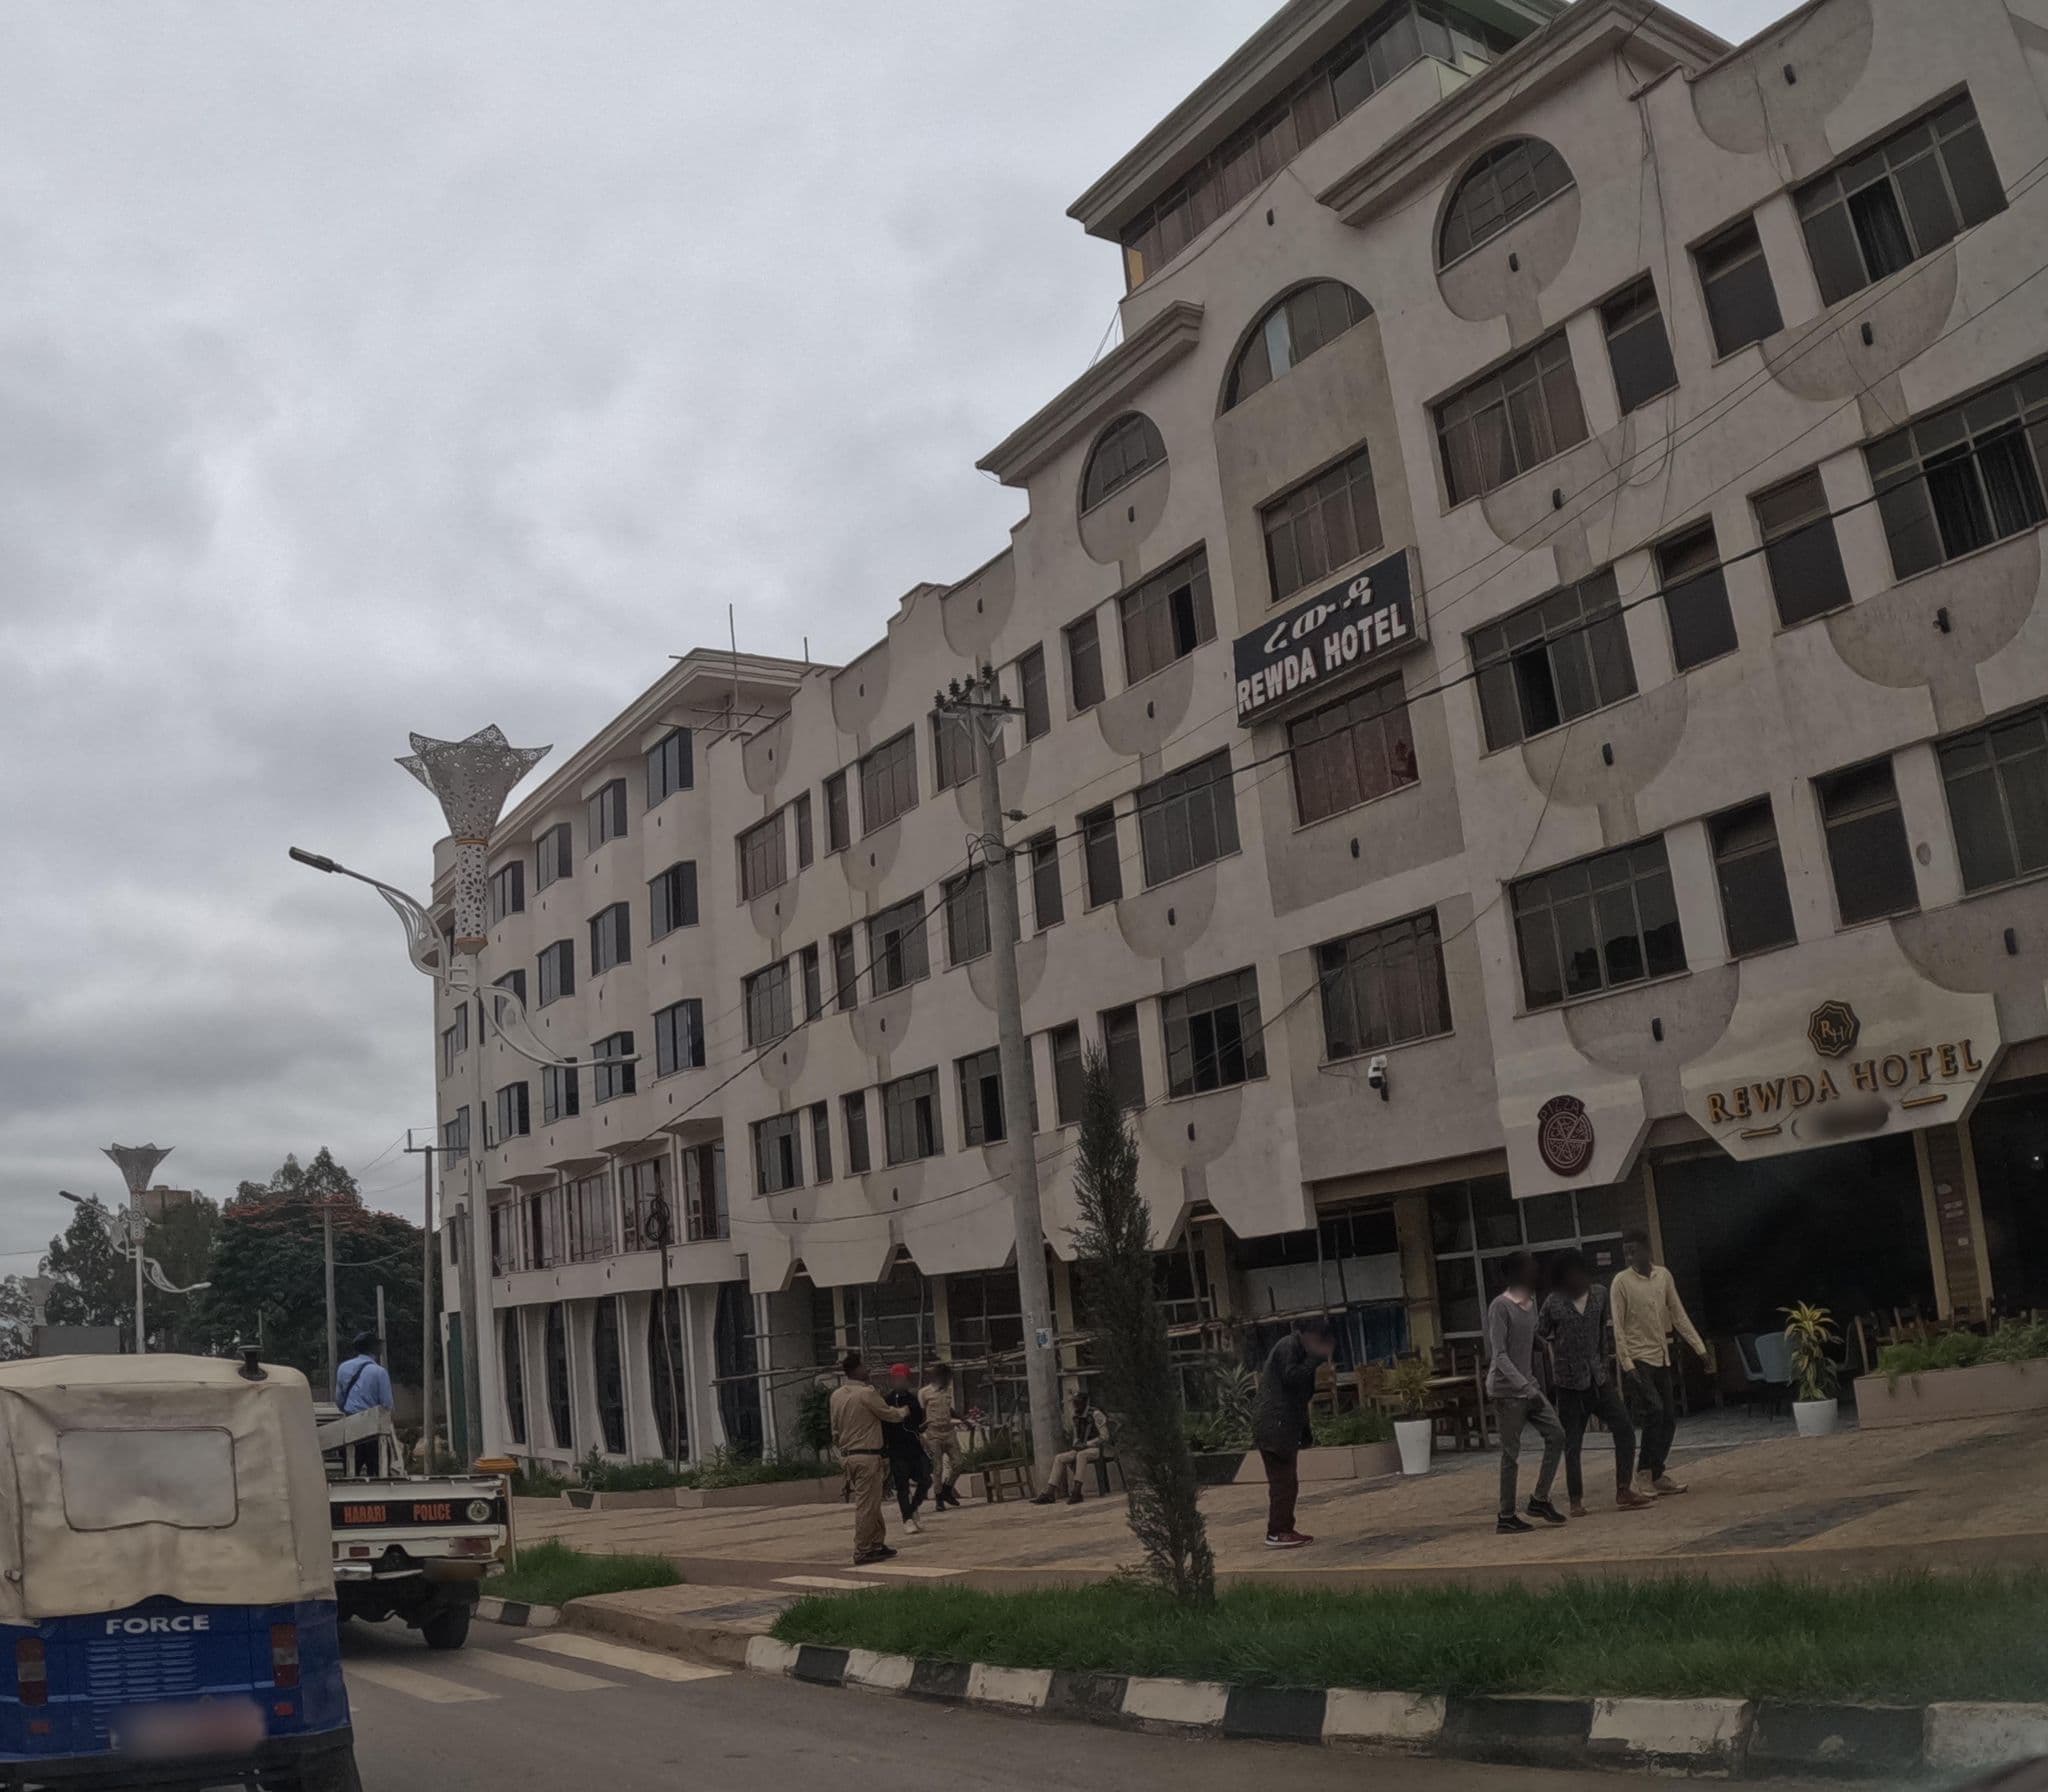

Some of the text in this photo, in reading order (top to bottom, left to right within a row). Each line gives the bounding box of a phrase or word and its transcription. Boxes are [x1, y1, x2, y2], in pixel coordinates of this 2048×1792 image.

[1237, 602, 1407, 714] REWDA HOTEL
[1706, 1068, 1840, 1124] REWDA
[1849, 1038, 1982, 1092] HOTEL
[1539, 1096, 1581, 1122] PIZZA
[413, 1503, 452, 1521] POLICE
[105, 1614, 211, 1635] FORCE
